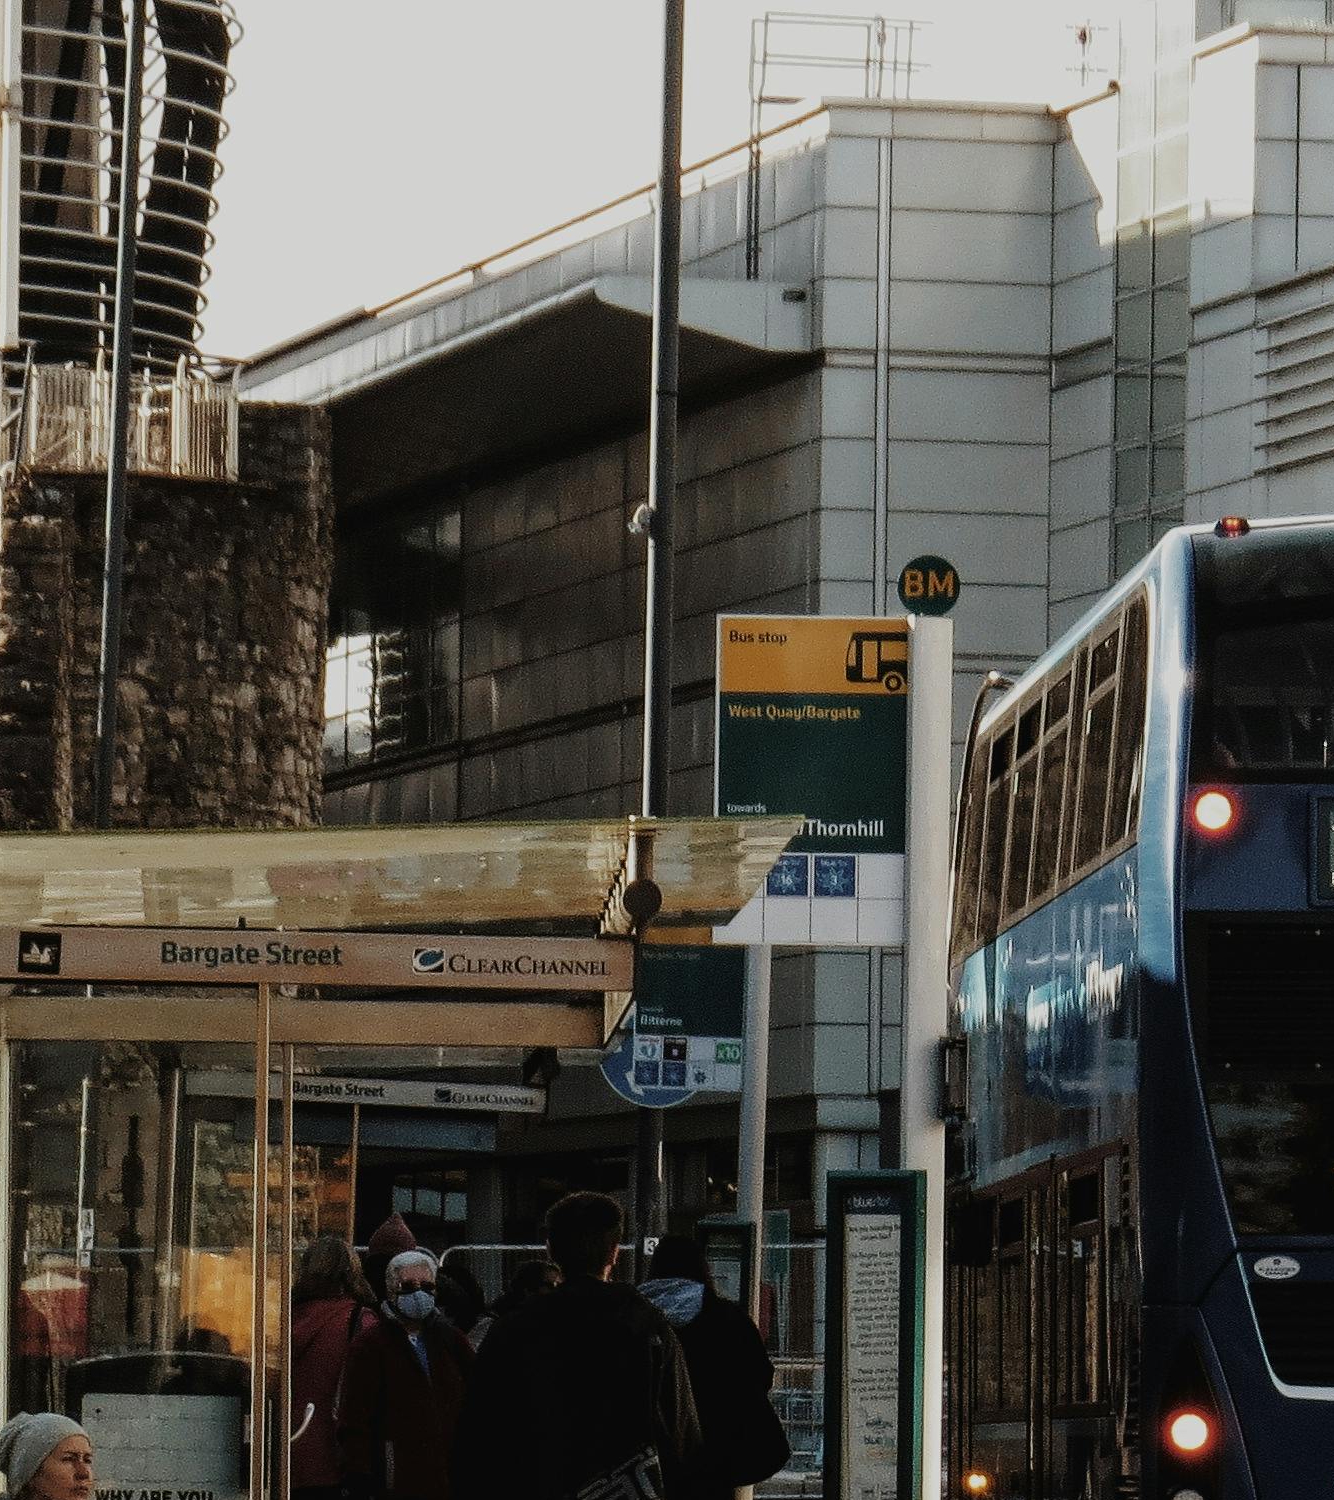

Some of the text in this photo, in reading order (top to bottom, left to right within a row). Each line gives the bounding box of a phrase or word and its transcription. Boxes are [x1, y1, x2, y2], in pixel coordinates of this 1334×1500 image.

[903, 568, 955, 599] BM
[729, 630, 788, 646] Bus stop
[728, 704, 763, 719] West
[160, 940, 344, 968] Bargate Street
[293, 1080, 386, 1099] Bargate Street
